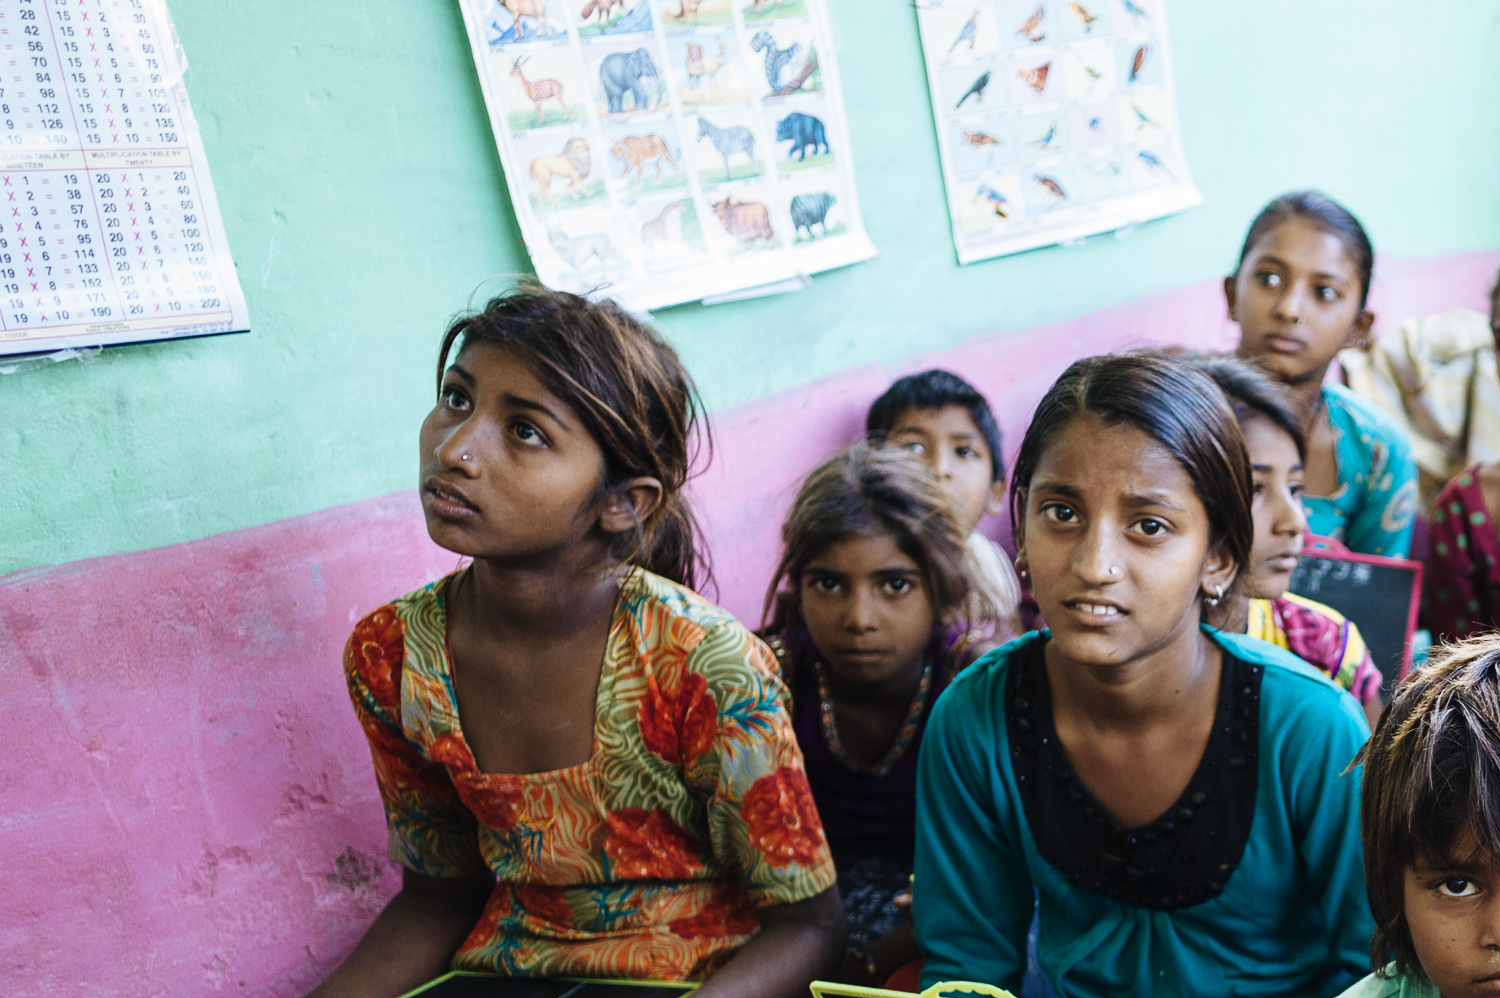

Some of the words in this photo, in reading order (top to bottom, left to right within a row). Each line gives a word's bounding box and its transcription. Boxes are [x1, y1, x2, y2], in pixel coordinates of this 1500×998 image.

[20, 10, 35, 20] 28
[56, 11, 71, 21] 15
[99, 12, 106, 22] 2
[133, 14, 146, 24] 30
[24, 26, 40, 36] 42
[60, 27, 75, 37] 15
[103, 28, 110, 37] 3
[139, 29, 150, 39] 45
[28, 41, 44, 52] 56
[64, 42, 79, 52] 15
[107, 43, 114, 52] 4
[142, 44, 154, 54] 60
[31, 57, 47, 67] 70
[68, 58, 82, 67] 15
[111, 58, 118, 68] 5
[147, 59, 158, 69] 75
[36, 73, 51, 83] 84
[72, 73, 86, 83] 15
[114, 73, 122, 83] 6
[150, 74, 161, 83] 90
[40, 88, 55, 98] 98
[76, 89, 90, 98] 15
[118, 89, 124, 98] 7
[148, 89, 166, 98] 105
[2, 104, 10, 114] 8
[37, 104, 59, 113] 112
[80, 104, 94, 114] 15
[122, 104, 129, 113] 8
[152, 104, 170, 113] 120
[6, 119, 14, 130] 9
[41, 119, 63, 129] 126
[84, 119, 98, 129] 15
[125, 118, 132, 128] 9
[156, 119, 174, 128] 135
[46, 134, 67, 144] 140
[87, 134, 101, 144] 15
[126, 134, 139, 143] 10
[159, 133, 178, 143] 150
[22, 175, 29, 185] 1
[64, 174, 78, 184] 19
[96, 173, 110, 183] 20
[174, 171, 186, 181] 20
[27, 191, 34, 201] 2
[67, 189, 81, 199] 38
[100, 188, 114, 198] 20
[141, 187, 149, 196] 2
[177, 186, 190, 195] 40
[31, 206, 38, 216] 3
[71, 205, 84, 214] 57
[103, 203, 117, 213] 20
[144, 202, 151, 211] 3
[181, 200, 193, 209] 60
[35, 221, 42, 231] 4
[74, 220, 88, 229] 76
[106, 218, 120, 227] 20
[148, 216, 154, 225] 4
[184, 214, 197, 224] 80
[39, 236, 46, 246] 5
[78, 234, 92, 244] 95
[110, 233, 123, 242] 20
[151, 231, 158, 240] 5
[181, 228, 200, 238] 100
[42, 251, 50, 261] 6
[74, 249, 95, 259] 114
[113, 247, 126, 257] 20
[154, 245, 161, 254] 6
[184, 242, 203, 252] 120
[116, 261, 130, 271] 20
[157, 259, 164, 268] 7
[1, 268, 15, 279] 19
[45, 266, 52, 275] 7
[78, 263, 98, 273] 133
[4, 283, 19, 294] 19
[49, 281, 57, 290] 8
[82, 278, 102, 288] 152
[10, 298, 23, 309] 19
[87, 292, 106, 302] 171
[130, 305, 144, 314] 20
[168, 301, 181, 310] 10
[200, 299, 220, 308] 200
[13, 313, 28, 323] 19
[56, 310, 70, 320] 10
[91, 307, 112, 317] 190
